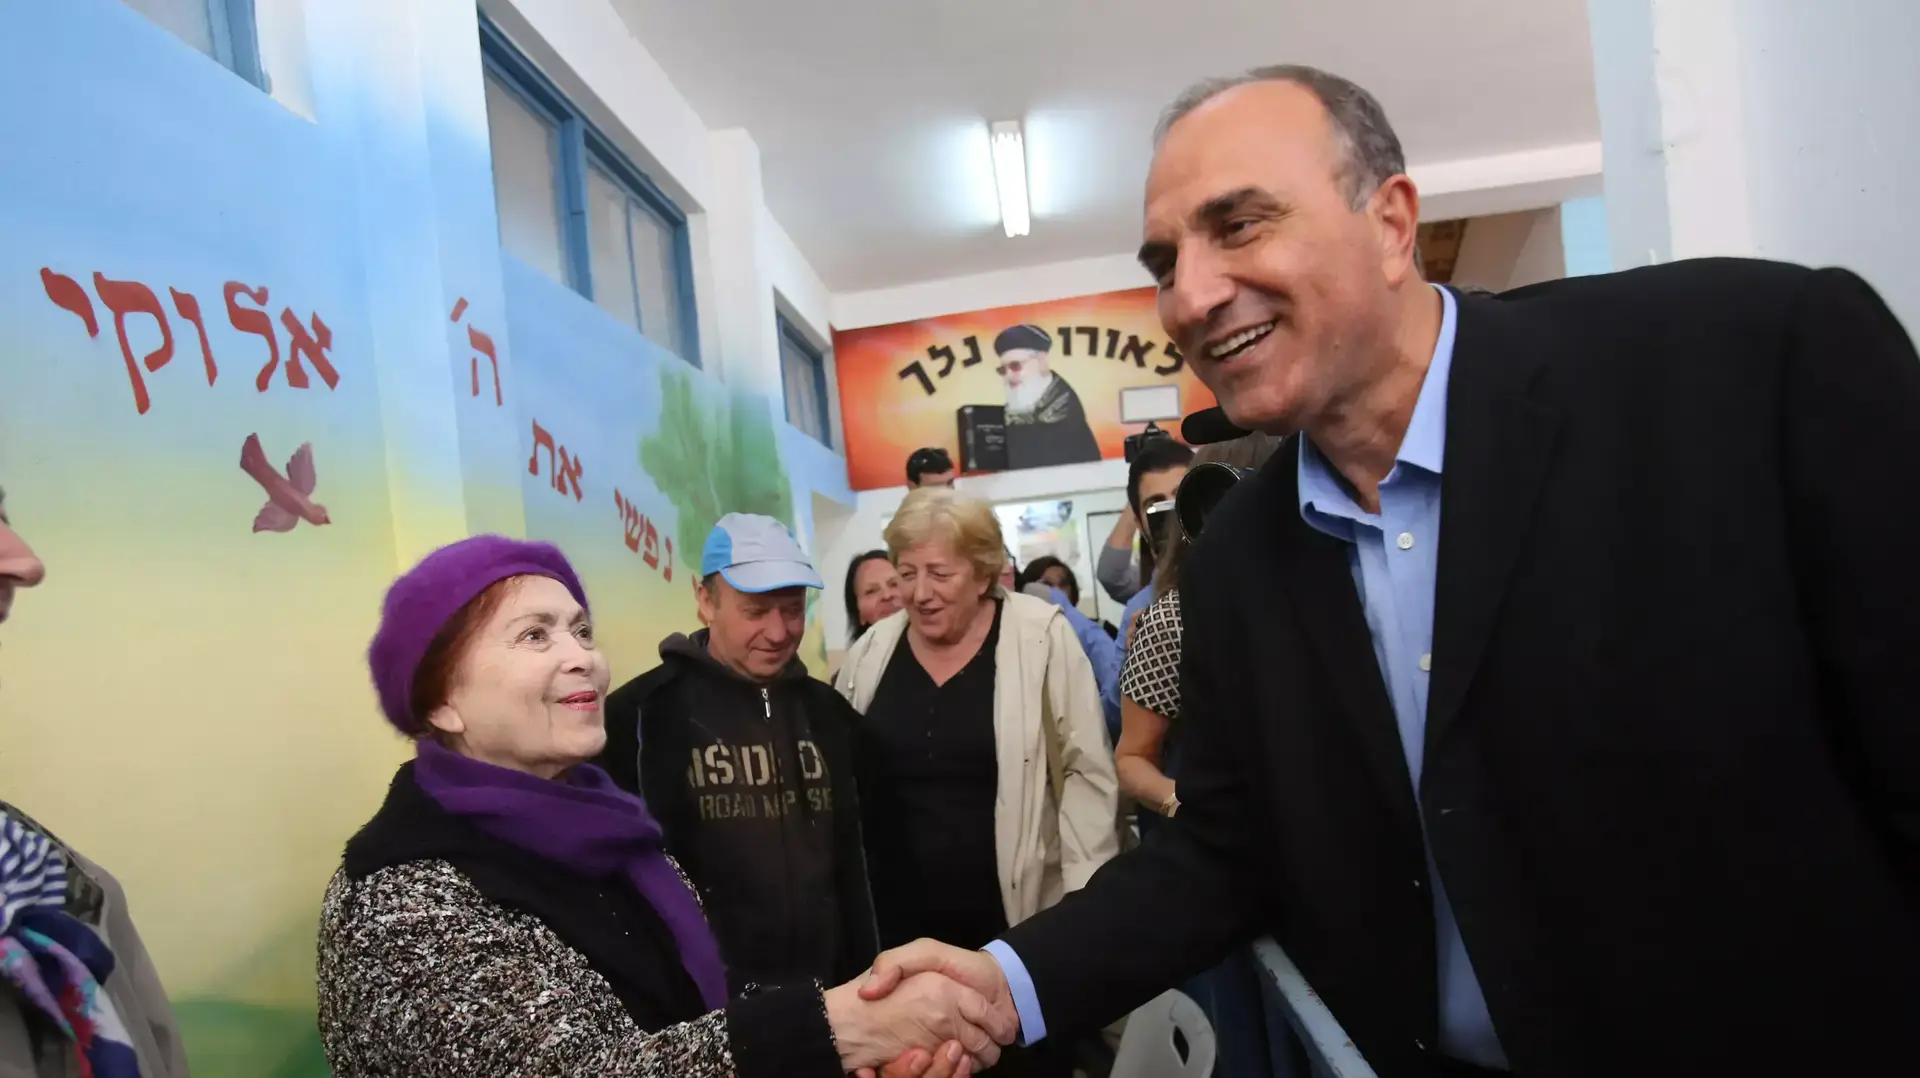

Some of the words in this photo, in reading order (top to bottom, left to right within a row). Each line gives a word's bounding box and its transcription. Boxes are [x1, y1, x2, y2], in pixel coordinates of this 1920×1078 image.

[40, 267, 340, 415] אלוקי
[897, 334, 982, 396] נלך
[1057, 326, 1184, 376] לאורו
[528, 417, 583, 502] את
[614, 487, 673, 583] נפשי
